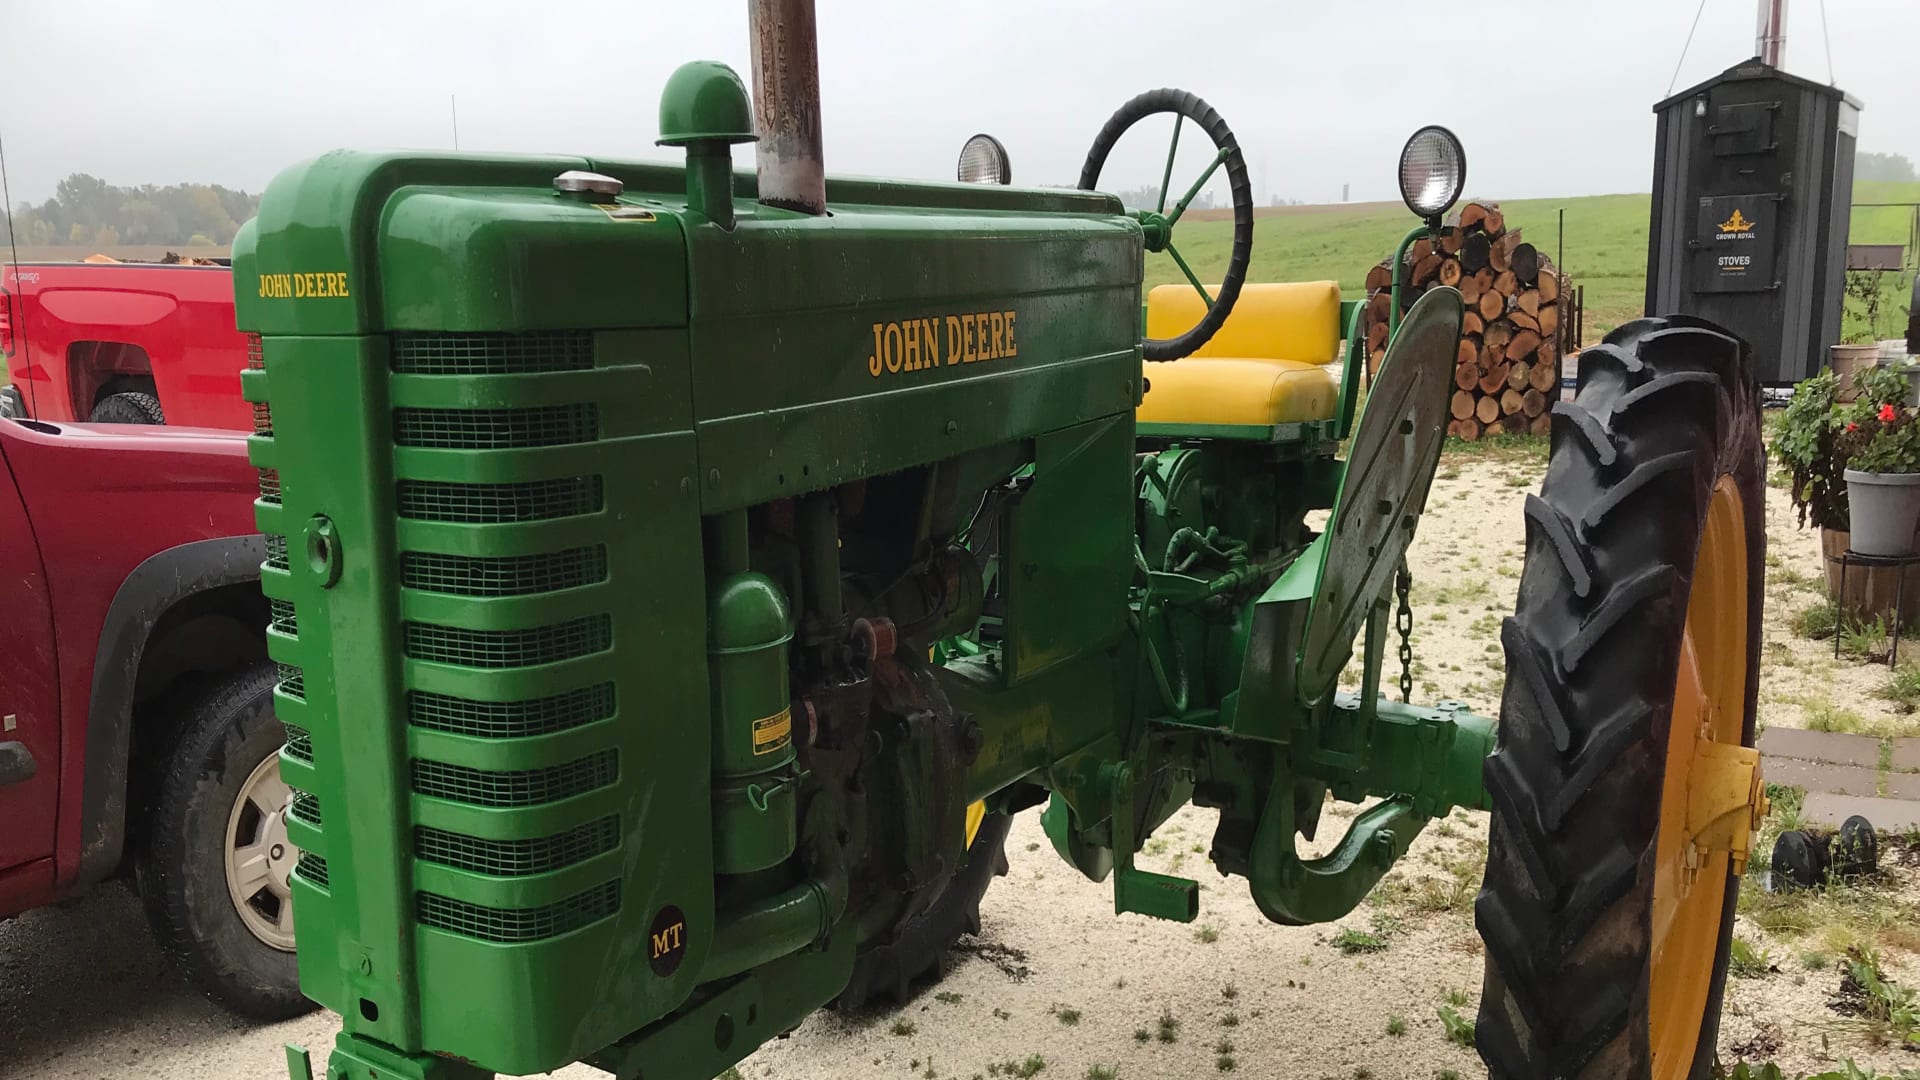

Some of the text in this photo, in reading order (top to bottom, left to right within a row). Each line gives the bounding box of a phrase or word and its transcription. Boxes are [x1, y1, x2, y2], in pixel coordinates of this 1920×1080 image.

[1715, 232, 1756, 240] CROWN ROYAL
[1718, 256, 1750, 266] STOVES
[259, 272, 349, 298] JOHN DEERE
[868, 310, 1018, 377] JOHN DEERE
[652, 921, 683, 959] MT
